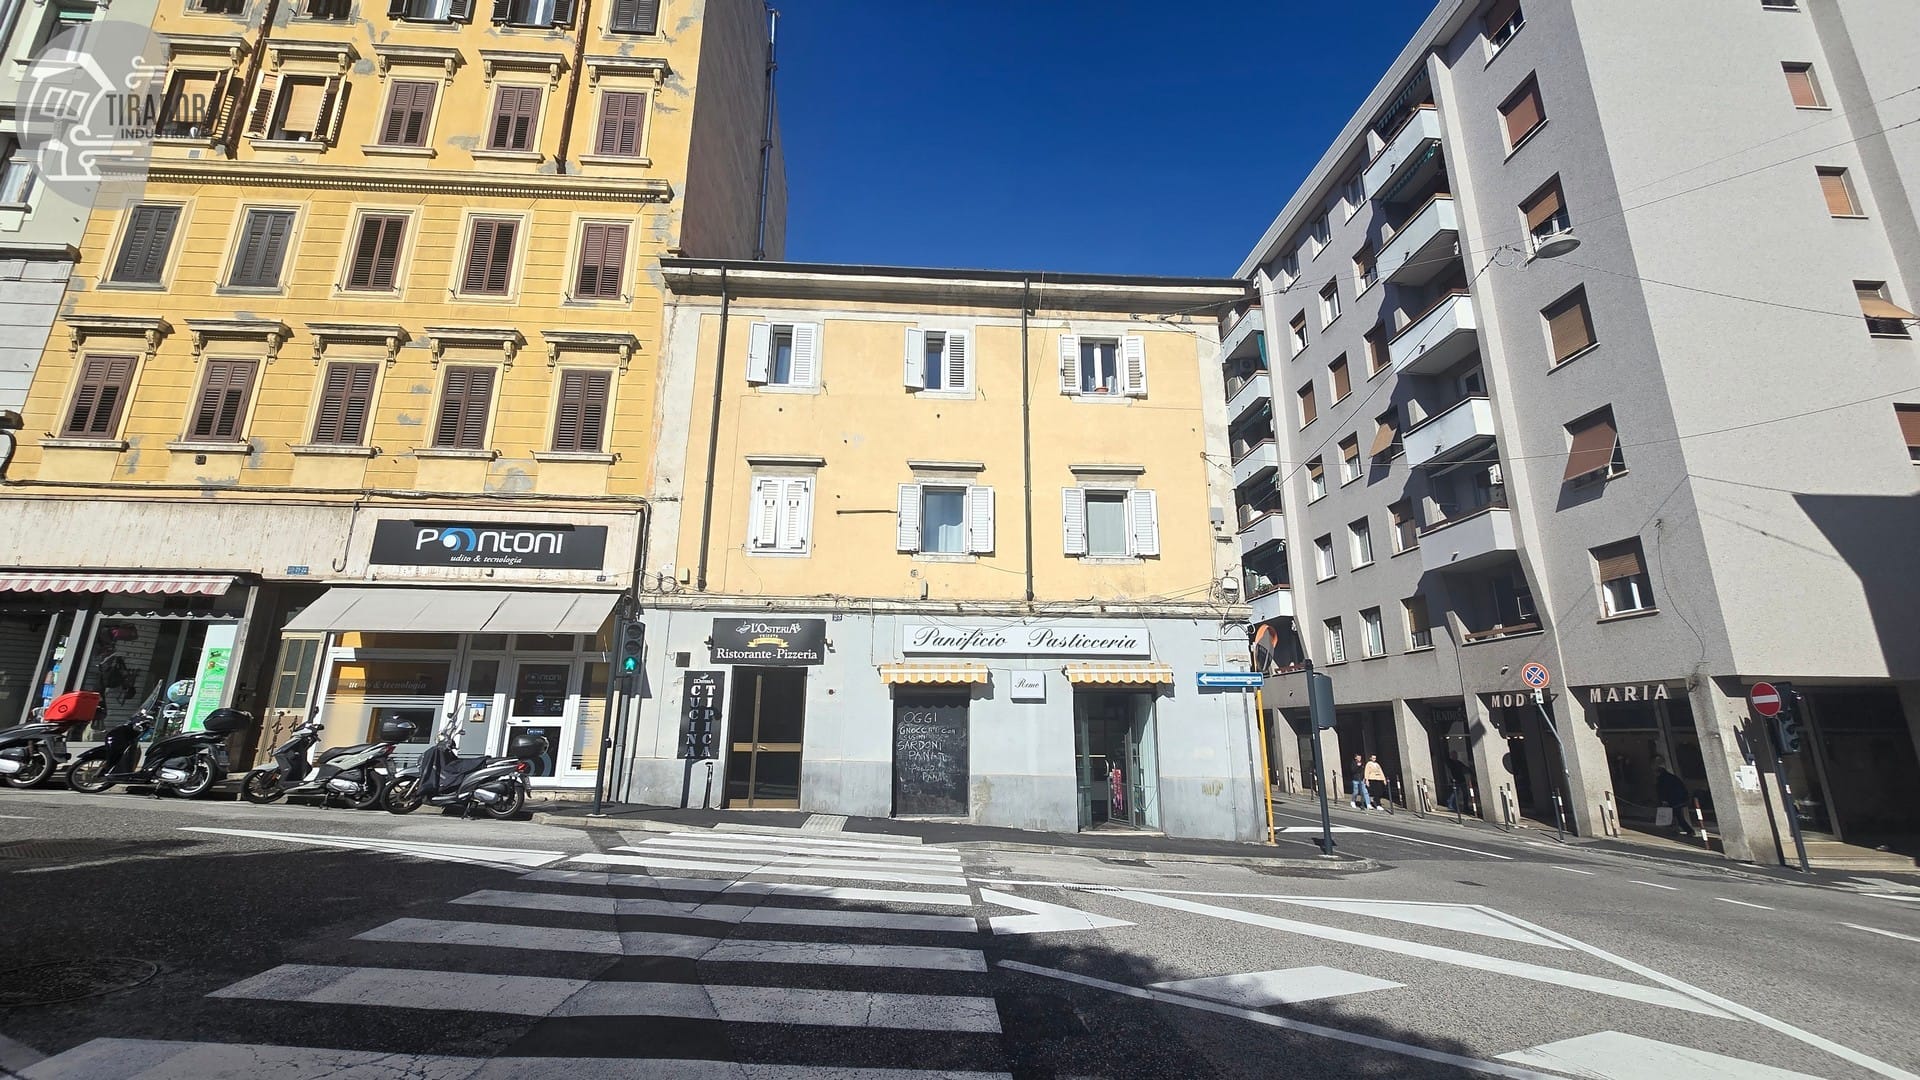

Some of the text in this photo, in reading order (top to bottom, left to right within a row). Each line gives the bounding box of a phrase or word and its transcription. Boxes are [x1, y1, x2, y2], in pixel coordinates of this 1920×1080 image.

[483, 556, 523, 564] tecnologia
[913, 627, 1138, 650] Panificio Pasticceria
[1590, 684, 1670, 704] MARIA
[684, 685, 701, 757] CUCINA
[700, 685, 716, 757] TIPICA
[904, 711, 937, 723] OGGI
